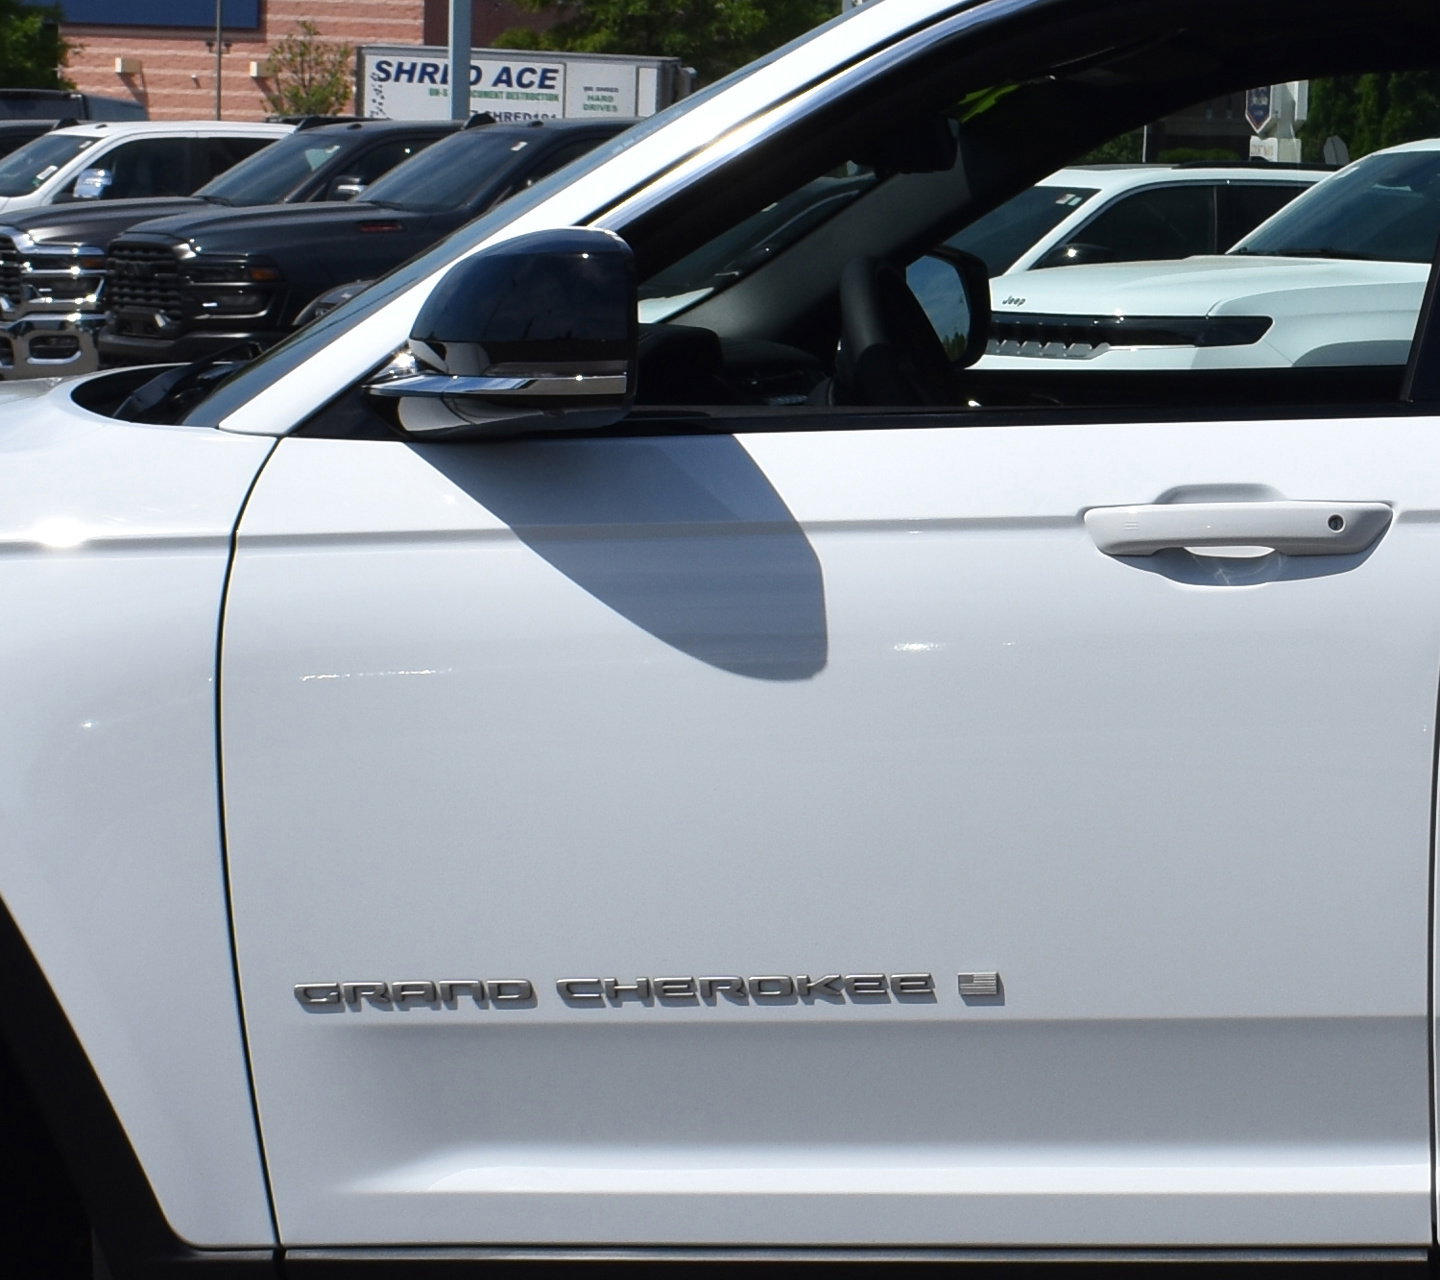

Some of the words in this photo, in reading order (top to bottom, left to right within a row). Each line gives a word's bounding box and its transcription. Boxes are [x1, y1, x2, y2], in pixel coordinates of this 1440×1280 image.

[492, 66, 559, 89] ACE
[293, 978, 537, 1007] GRAND
[556, 972, 937, 1001] CHEROKEE
